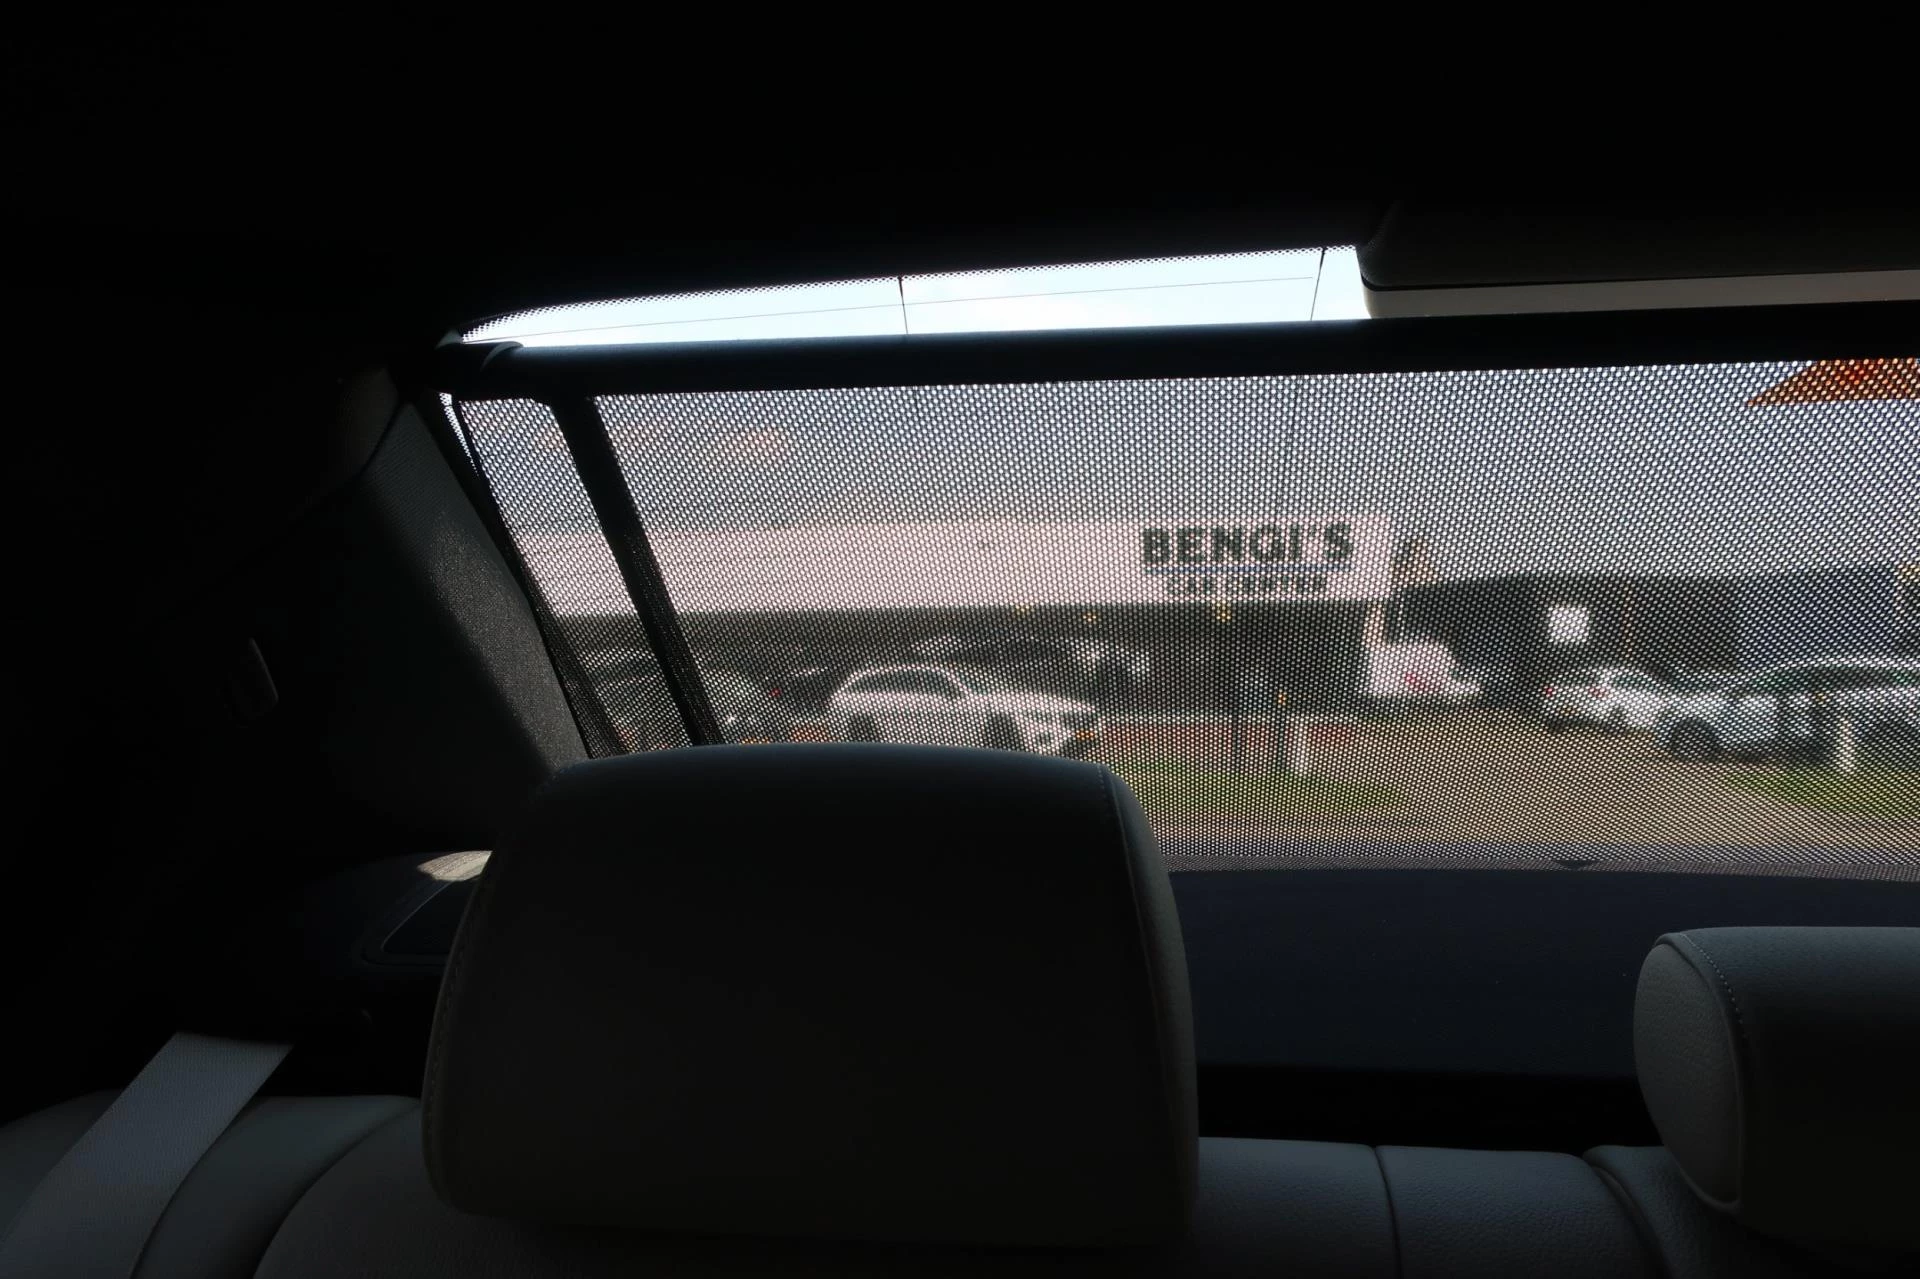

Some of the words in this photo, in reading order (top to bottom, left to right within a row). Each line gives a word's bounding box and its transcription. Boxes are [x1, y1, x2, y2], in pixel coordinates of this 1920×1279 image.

[1142, 523, 1352, 563] BENGI'S
[1167, 577, 1216, 595] CAR
[1225, 575, 1327, 595] CENTER
